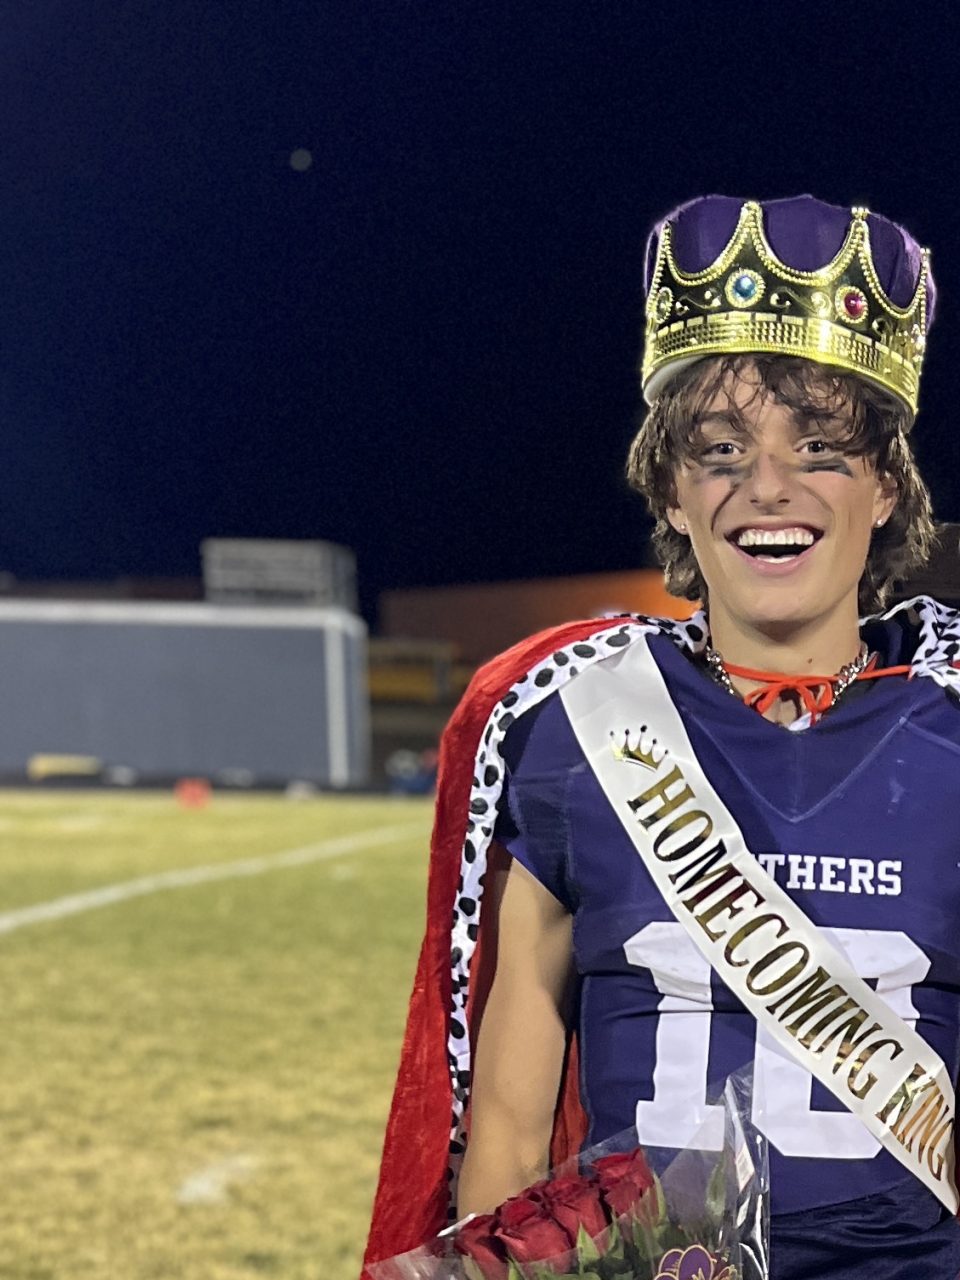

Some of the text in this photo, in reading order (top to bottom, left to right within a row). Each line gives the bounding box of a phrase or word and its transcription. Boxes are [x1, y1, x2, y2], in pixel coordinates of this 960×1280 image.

[627, 764, 954, 1181] HOMECOMING KING
[751, 853, 902, 896] THERS
